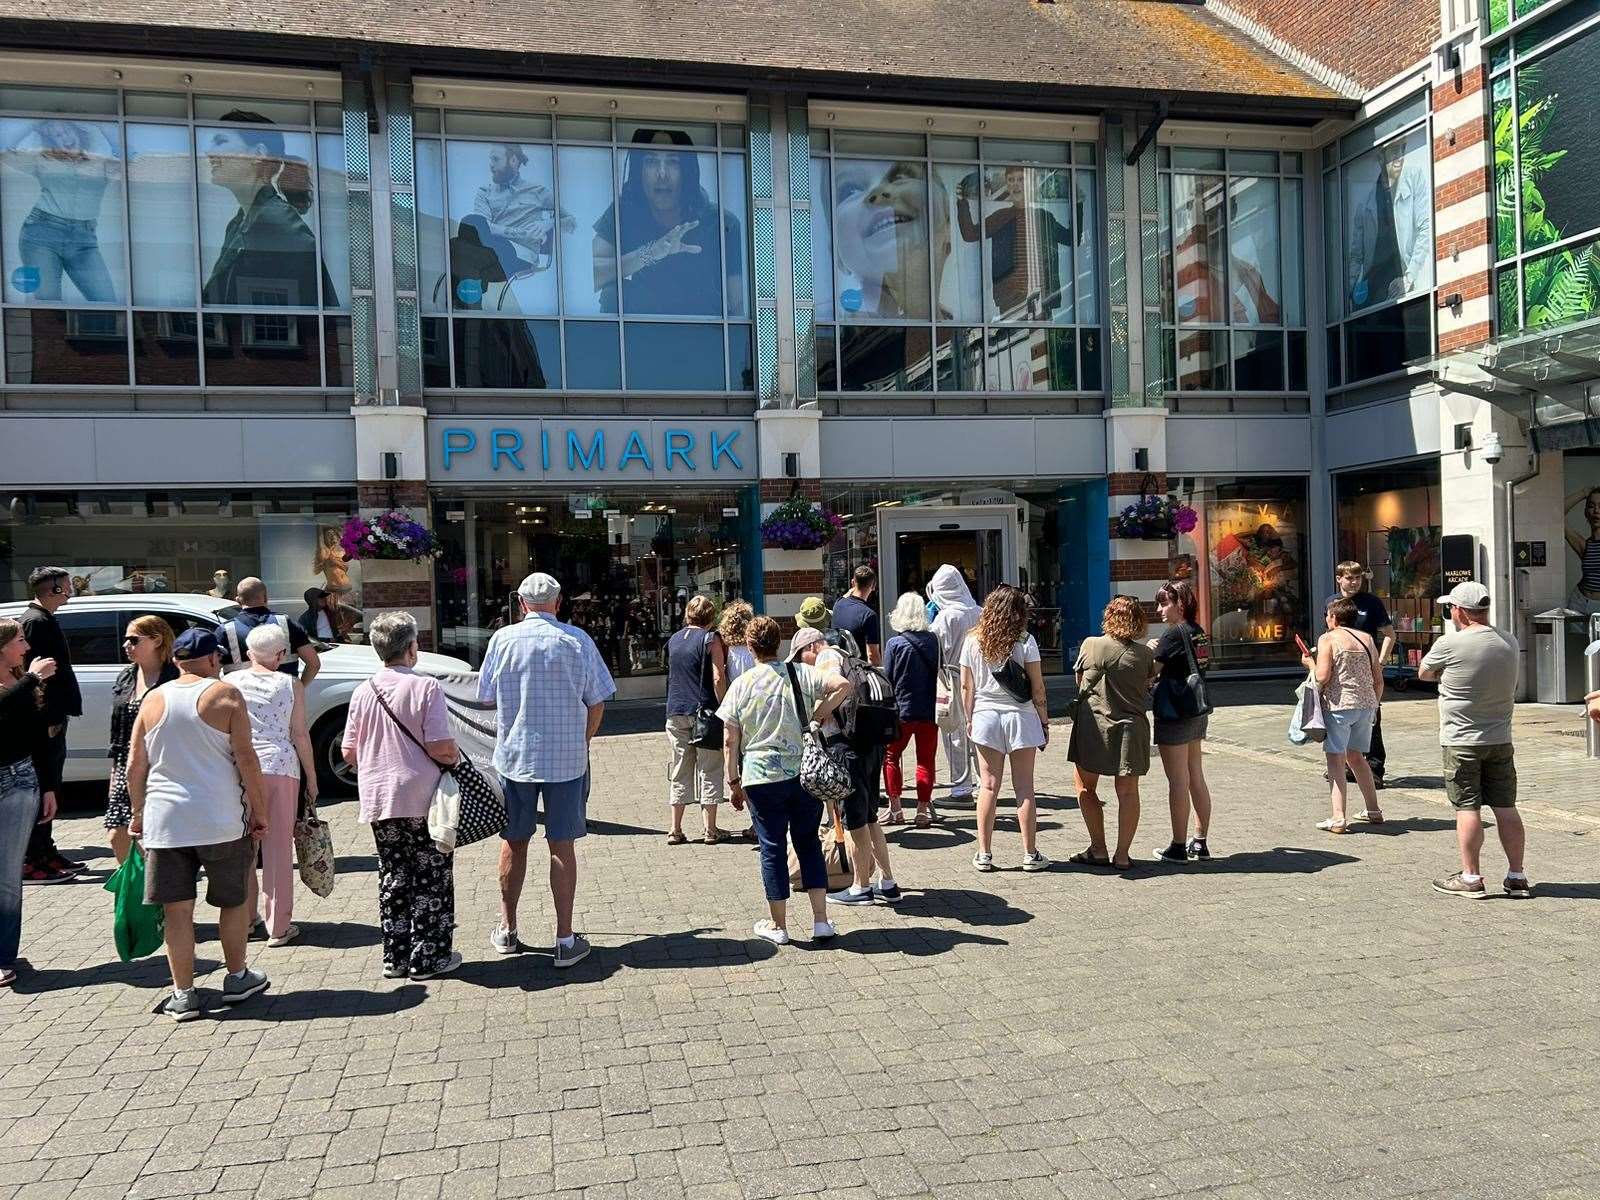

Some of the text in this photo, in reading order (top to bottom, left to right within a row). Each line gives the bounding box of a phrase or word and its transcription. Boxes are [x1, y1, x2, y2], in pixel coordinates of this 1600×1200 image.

[442, 427, 744, 472] PRIMARK
[1444, 569, 1472, 577] MARLOWE
[1218, 623, 1295, 640] UMME
